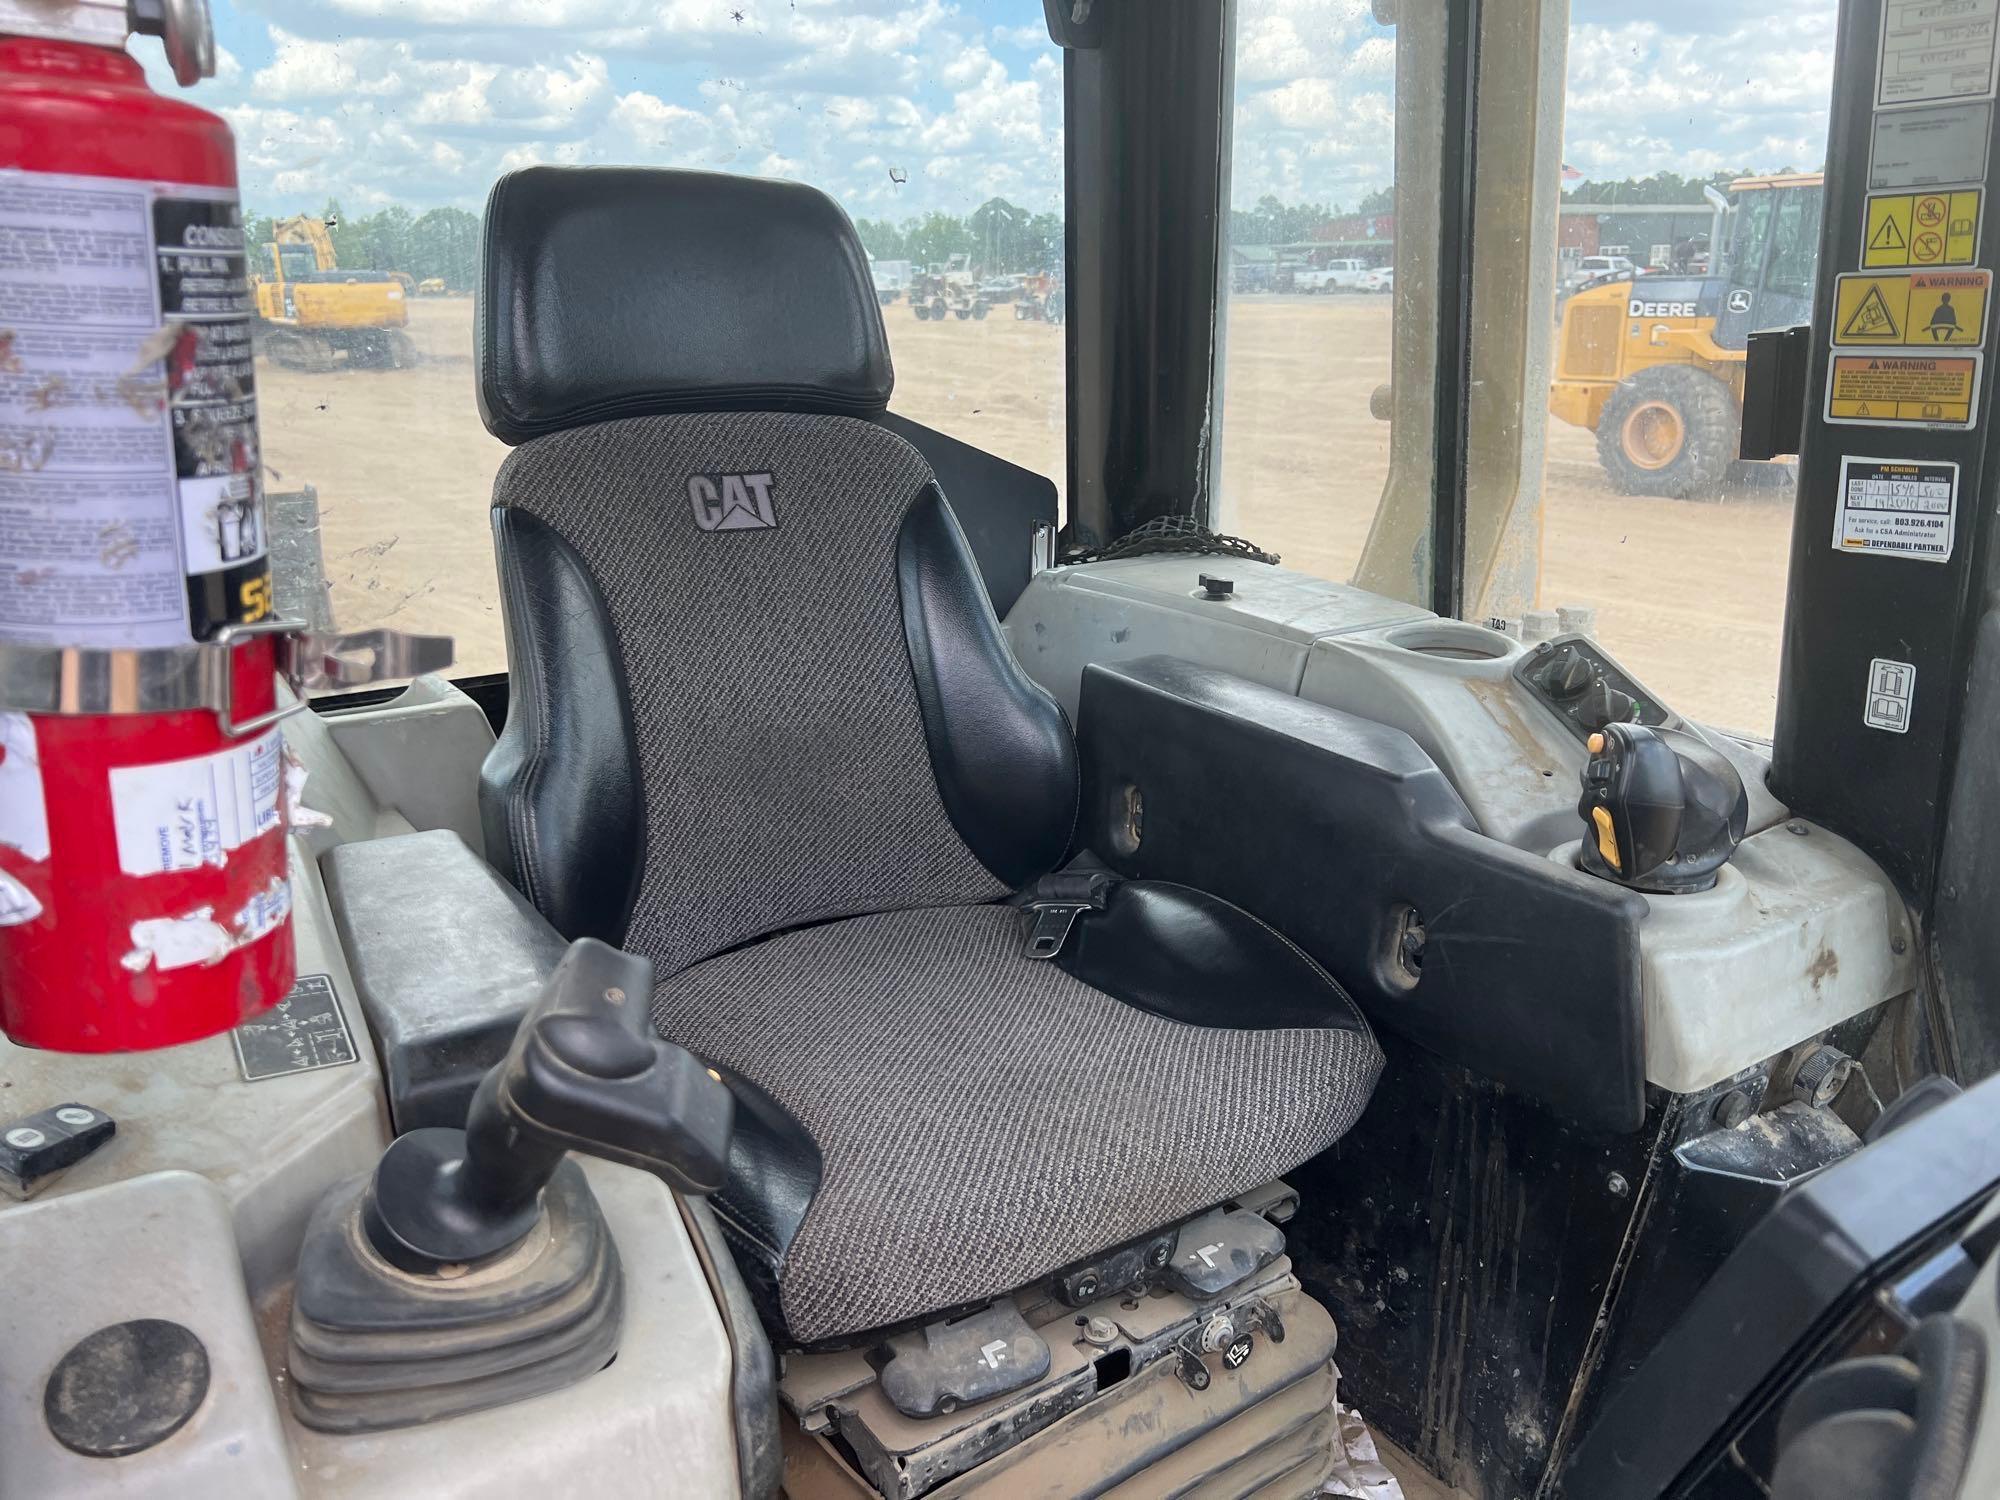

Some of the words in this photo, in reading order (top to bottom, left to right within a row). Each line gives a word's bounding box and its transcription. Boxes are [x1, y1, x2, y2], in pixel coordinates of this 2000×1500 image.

[1929, 276, 1984, 287] WARNING
[1629, 300, 1696, 317] DEERE
[1882, 360, 1937, 370] WARNING
[1890, 466, 1919, 474] SCHEDULE
[688, 473, 778, 531] CAT
[1894, 518, 1944, 528] 803.926.4104
[1894, 529, 1937, 538] Administrator
[1871, 540, 1912, 550] DEPENDABLE
